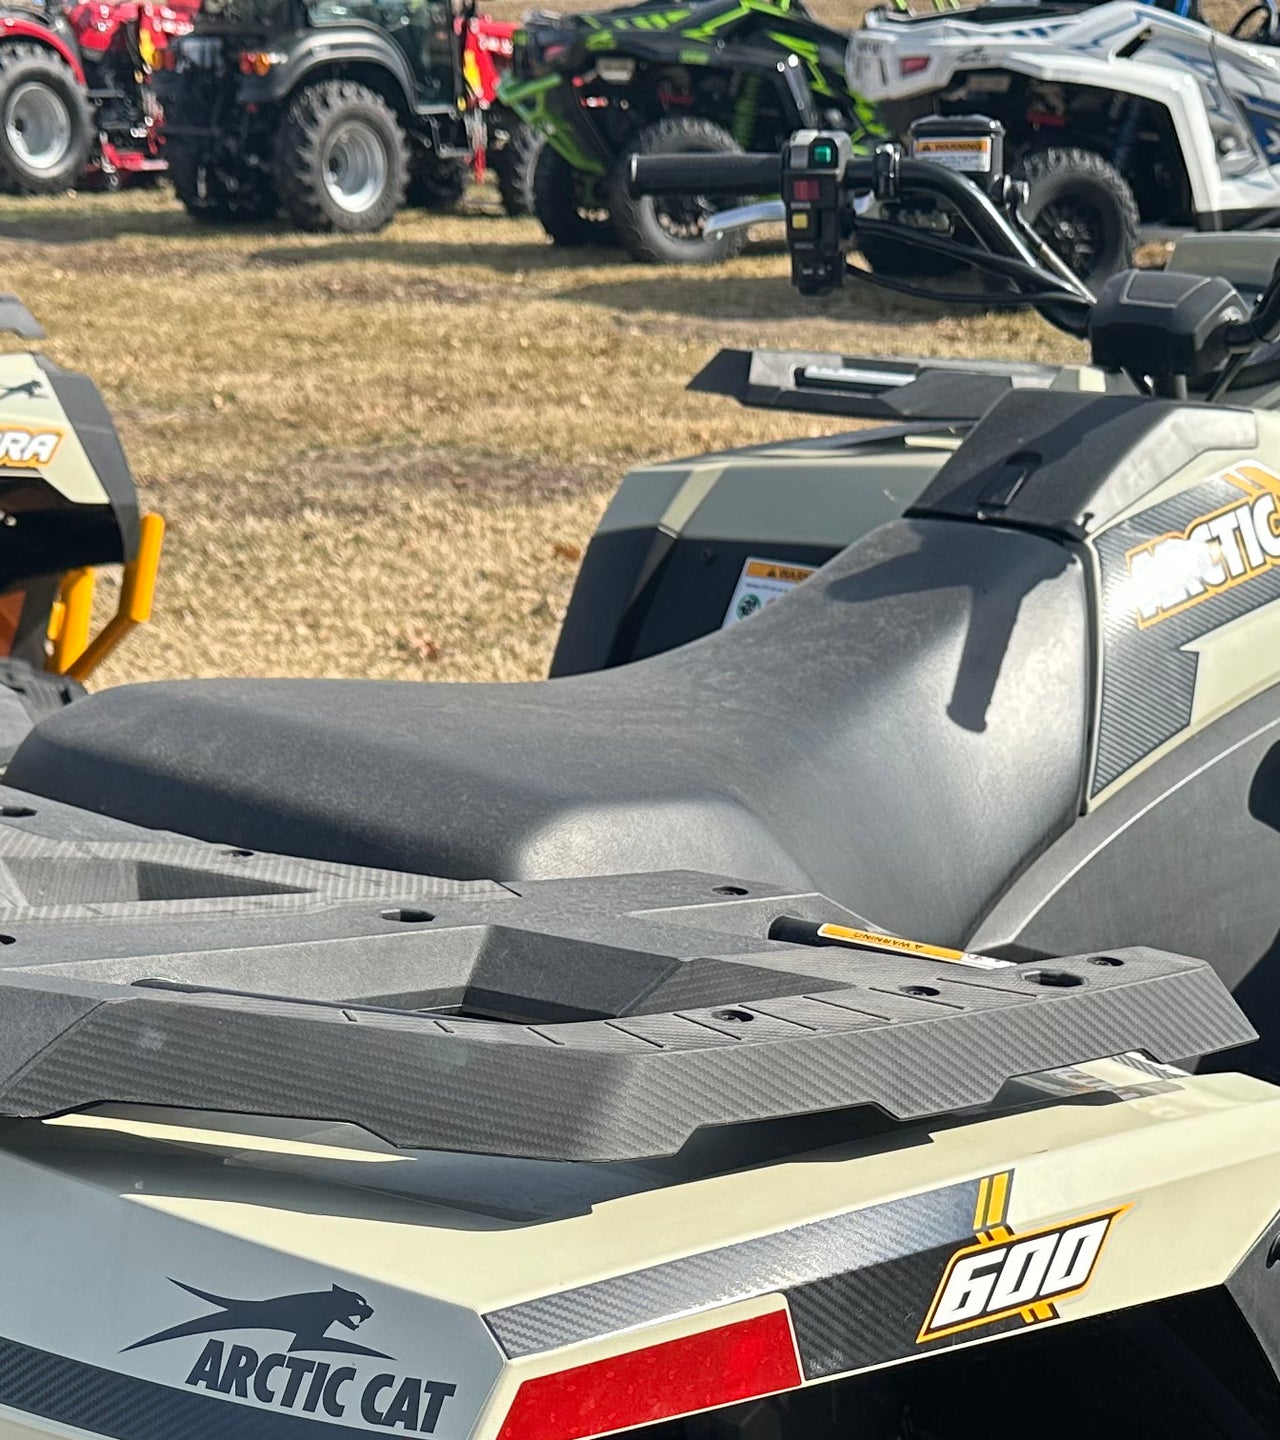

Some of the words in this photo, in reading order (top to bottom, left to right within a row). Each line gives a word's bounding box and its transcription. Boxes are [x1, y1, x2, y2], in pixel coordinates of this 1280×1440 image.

[853, 931, 911, 949] WARNING
[929, 1217, 1111, 1330] 600
[185, 1338, 357, 1418] ARCTIC
[360, 1373, 458, 1434] CAT
